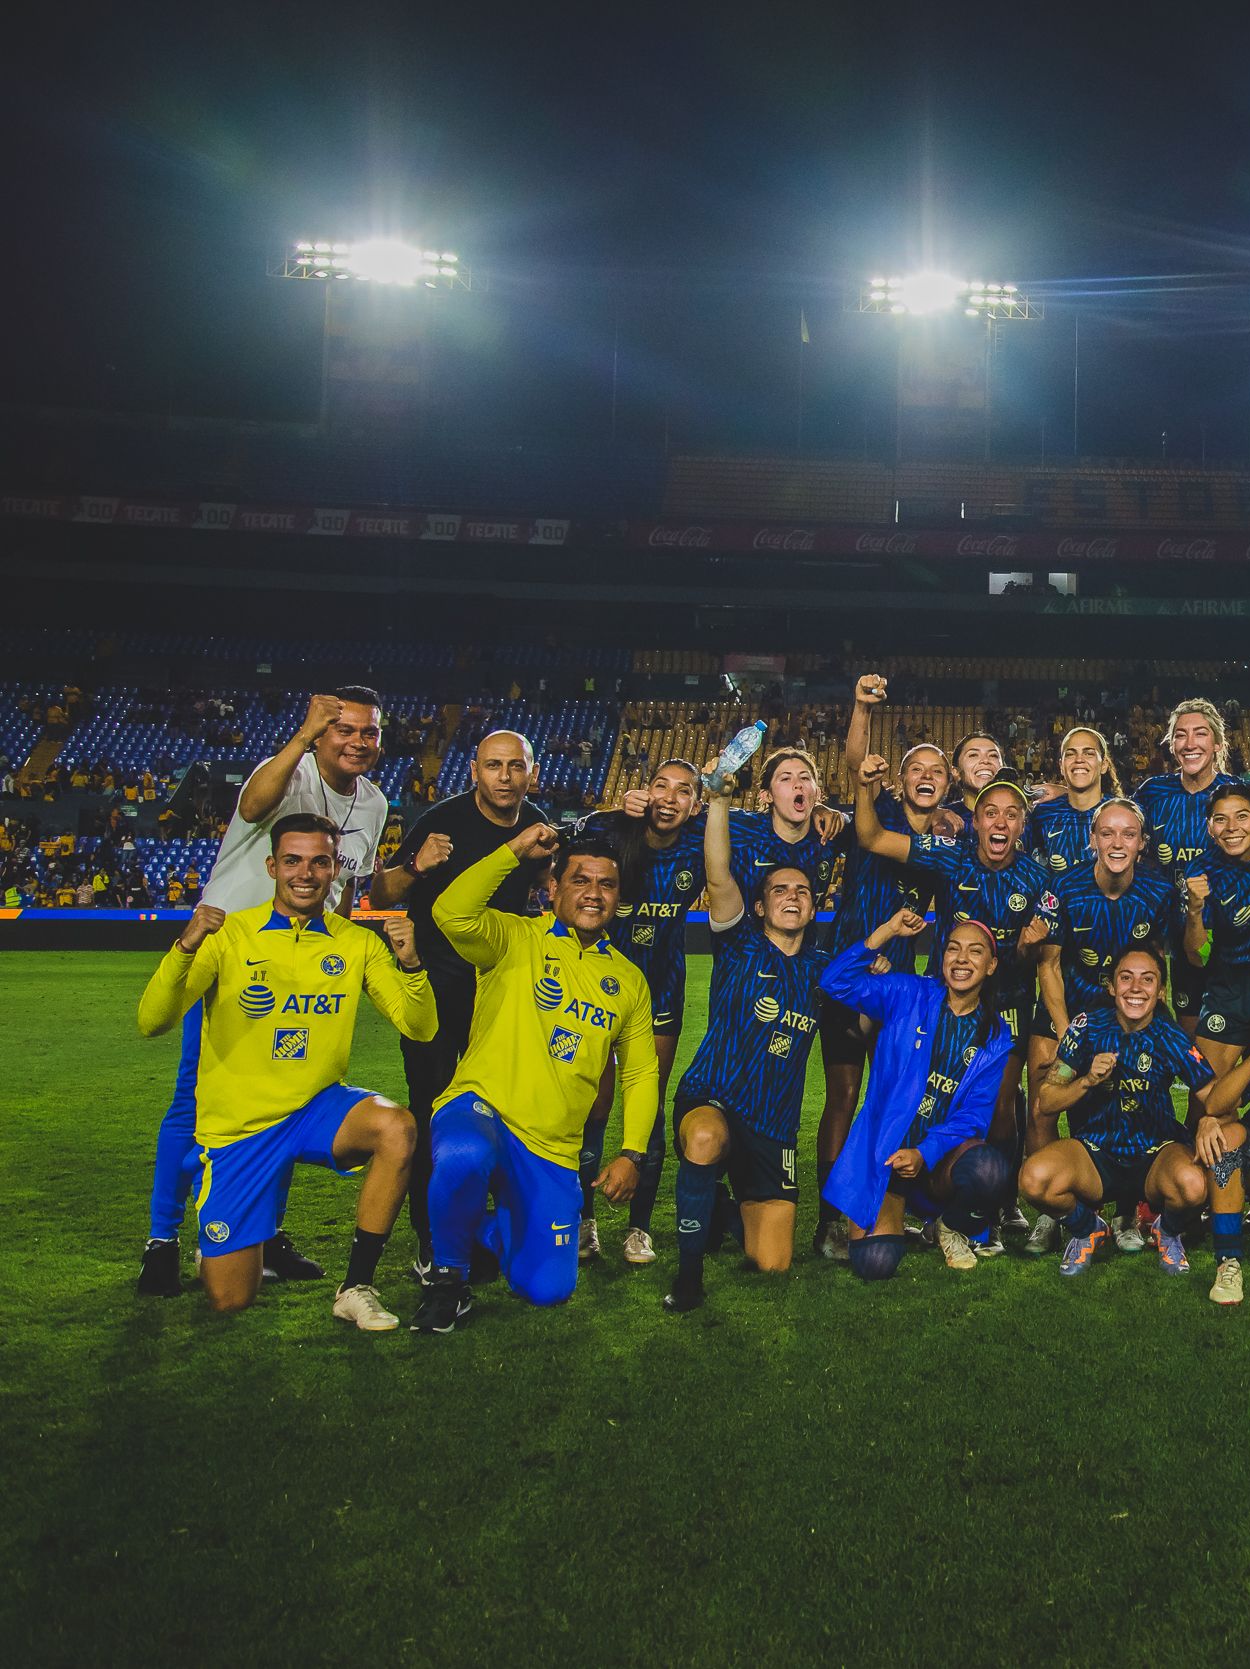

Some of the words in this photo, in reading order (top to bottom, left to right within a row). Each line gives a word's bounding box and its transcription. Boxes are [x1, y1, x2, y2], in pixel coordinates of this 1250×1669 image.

[2, 497, 60, 514] TECATE
[123, 505, 179, 522] TECATE
[241, 512, 296, 530] TECATE
[357, 518, 410, 535] TECATE
[466, 522, 519, 539] TECATE
[1066, 599, 1133, 615] AFIRME
[1180, 600, 1247, 616] AFIRME
[336, 851, 357, 871] ÉRICA
[1176, 848, 1207, 862] AT&
[637, 903, 681, 917] AT&T
[632, 924, 653, 943] HOME
[281, 994, 347, 1015] AT&T
[564, 998, 617, 1031] AT&T
[780, 1010, 817, 1033] AT&T
[274, 1030, 306, 1058] HOME
[550, 1034, 578, 1055] HOME
